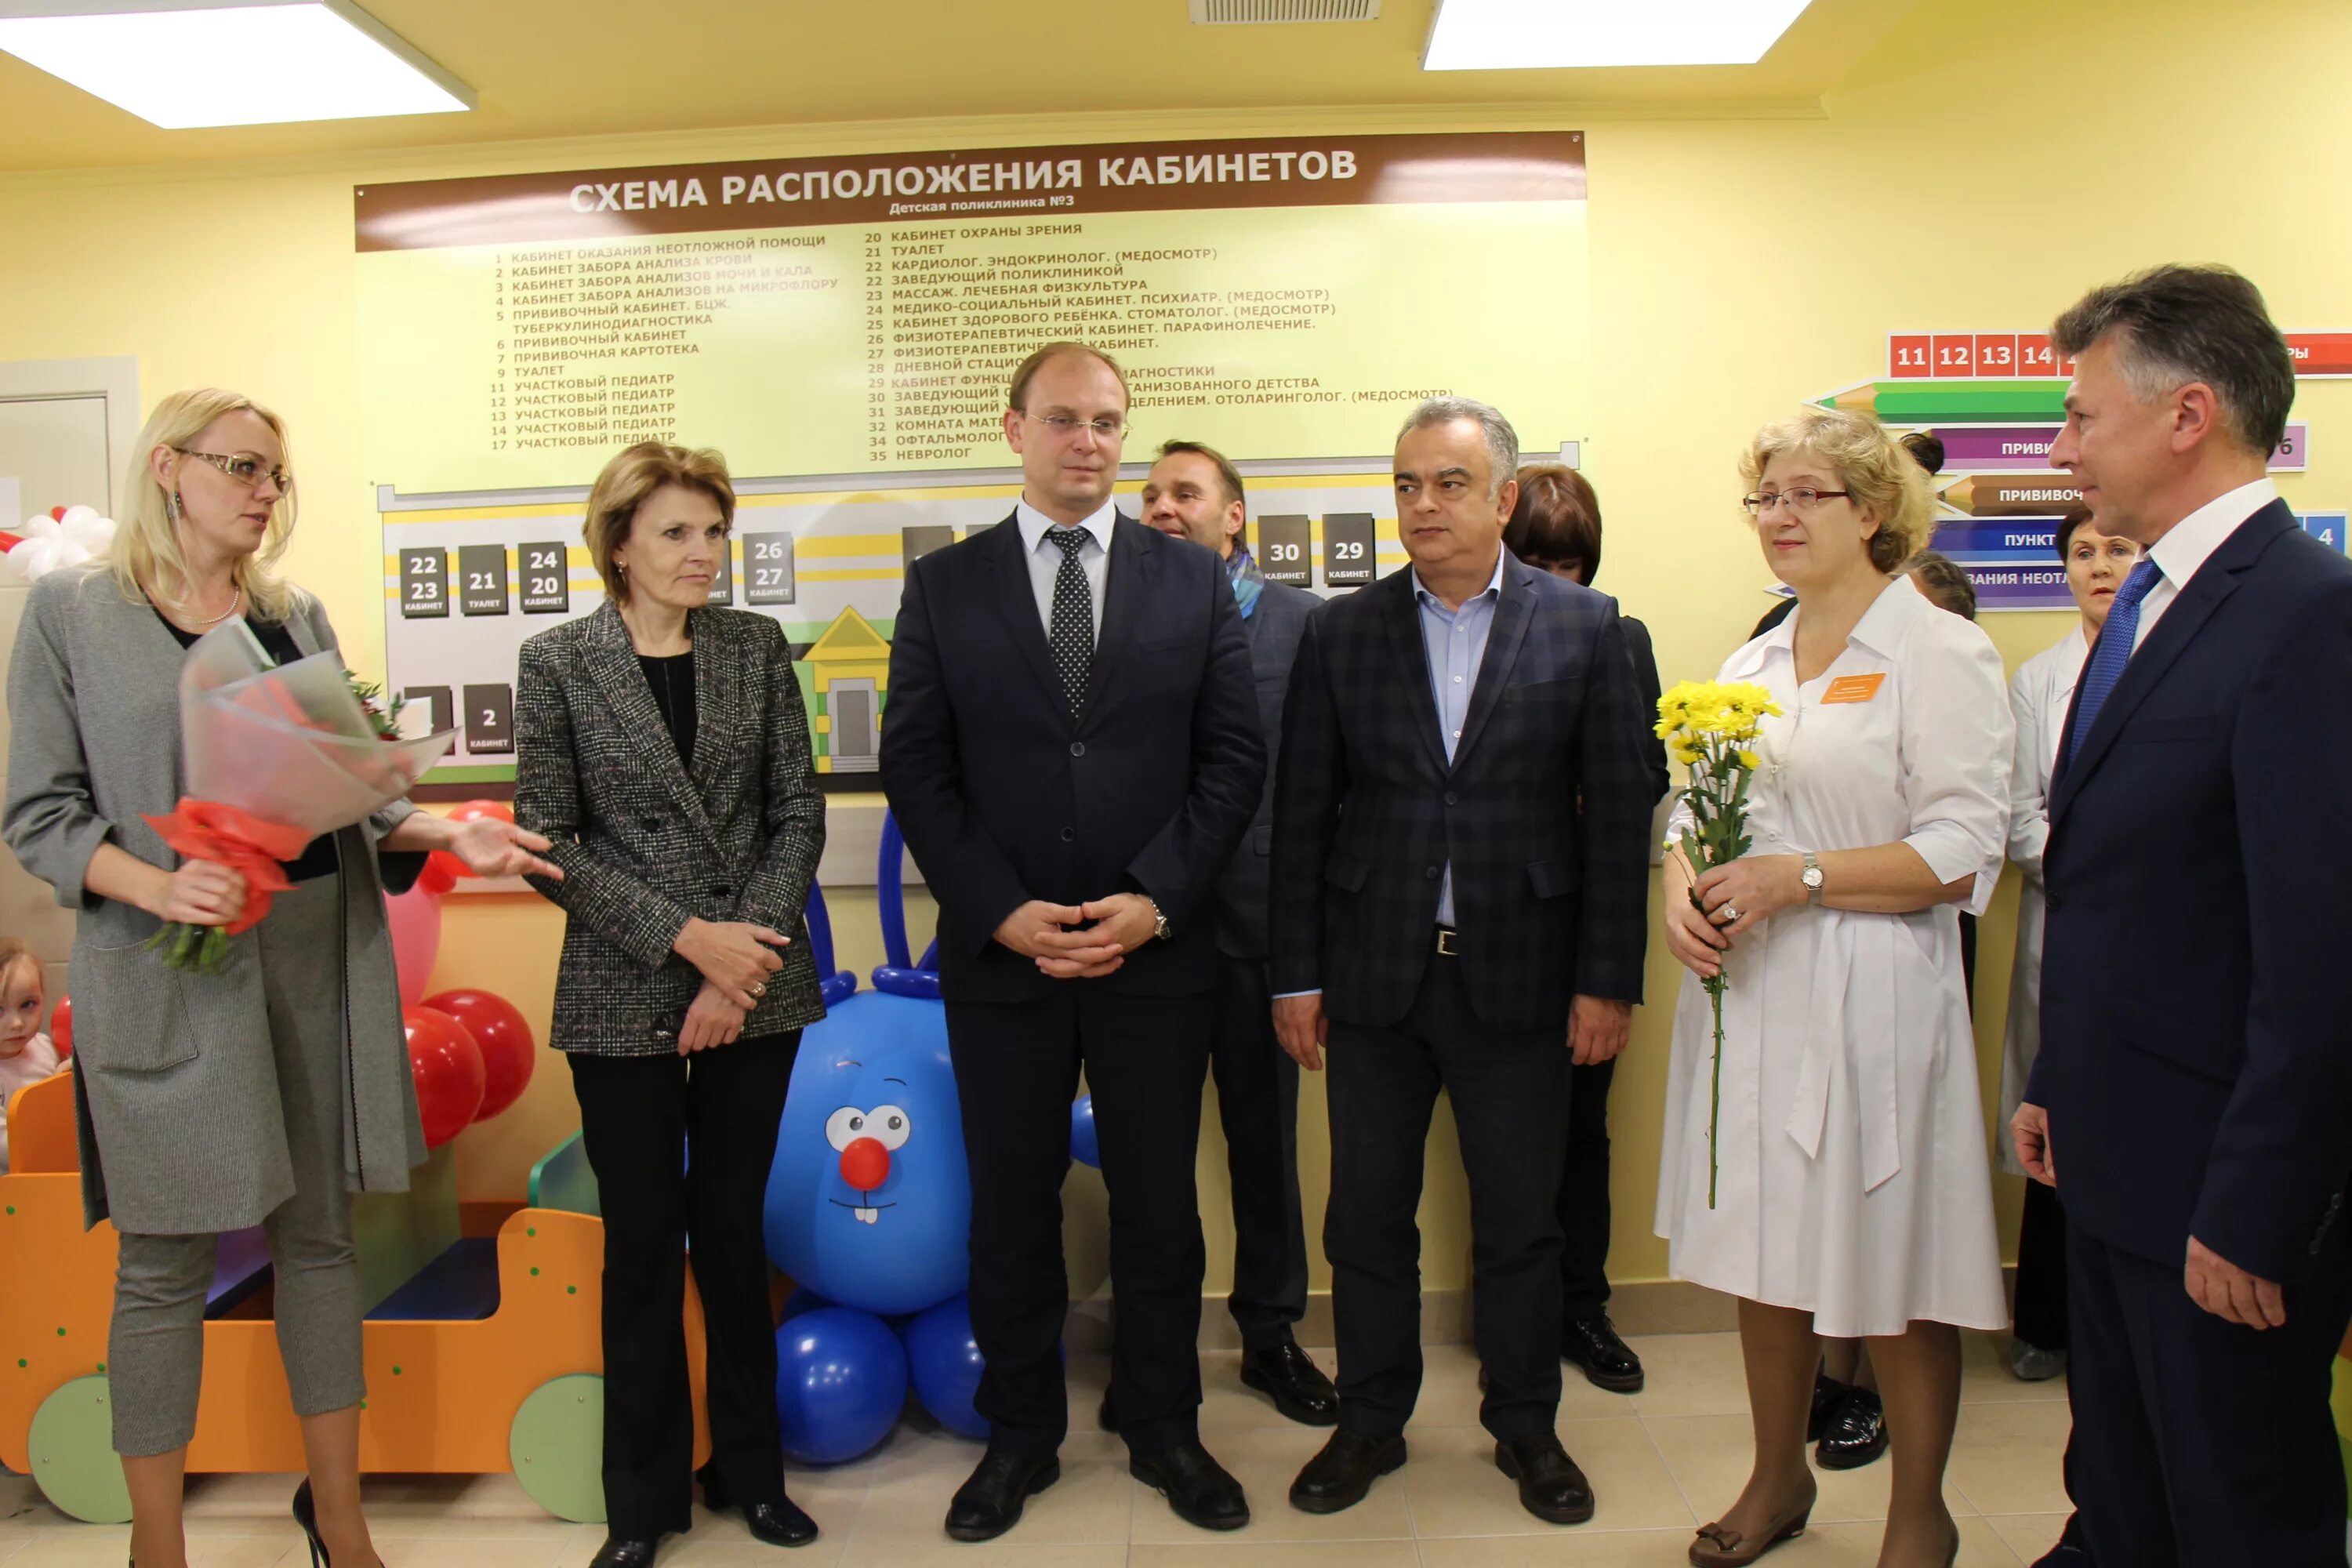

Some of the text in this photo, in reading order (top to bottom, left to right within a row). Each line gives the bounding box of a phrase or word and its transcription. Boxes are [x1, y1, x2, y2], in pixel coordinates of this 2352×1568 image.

[569, 151, 1356, 214] СХЕМА РАСПОЛОЖЕНИЯ КАБИНЕТОВ
[890, 195, 1075, 216] Детская поликлиника №3
[866, 223, 1081, 243] 20 КАБИНЕТ ОХРАНЫ ЗРЕНИЯ
[496, 236, 825, 264] 1 КАБИНЕТ ОКАЗАНИЯ НЕОТЛОЖНОЙ ПОМОЩИ
[866, 244, 944, 258] 21 ТУАЛЕТ
[496, 254, 751, 278] 2 КАБИНЕТ ЗАБОРА АНАЛИЗА КРОВИ
[866, 249, 1217, 272] 22 КАРДИОЛОГ. ЭНДОКРИНОЛОГ. (МЕДОСМОТР)
[497, 266, 812, 293] 3 КАБИНЕТ ЗАБОРА АНАЛИЗОВ МОЧИ И КАЛА
[867, 265, 1123, 286] 22 ЗАВЕДУЮЩИЙ ПОЛИКЛИНИКОЙ
[496, 278, 837, 307] 4 КАБИНЕТ ЗАБОРА АНАЛИЗОВ НА МИКРОФЛОРУ
[867, 280, 1147, 301] 23 МАССАЖ. ЛЕЧЕБНАЯ ФИЗКУЛЬТУРА
[497, 299, 730, 321] 5 ПРИВИВОЧНЫЙ КАБИНЕТ. БЦЖ.
[867, 289, 1329, 316] 24 МЕДИКО-СОЦИАЛЬНЫЙ КАБИНЕТ. ПСИХИАТР. (МЕДОСМОТР)
[514, 314, 712, 334] ТУБЕРКУЛИНОДИАГНОСТИКА
[867, 303, 1335, 330] 25 КАБИНЕТ ЗДОРОВОГО РЕБЁНКА. СТОМАТОЛОГ. (МЕДОСМОТР)
[497, 329, 685, 350] 6 ПРИВИВОЧНЫЙ КАБИНЕТ
[868, 319, 1315, 345] 26 ФИЗИОТЕРАПЕВТИЧЕСКИЙ КАБИНЕТ. ПАРАФИНОЛЕЧЕНИЕ.
[499, 343, 699, 364] 7 ПРИВИВОЧНАЯ КАРТОТЕКА
[868, 337, 1159, 359] 27 ФИЗИОТЕРАПЕВТИЧЕ КАБИНЕТ.
[1899, 347, 1925, 365] 11
[1940, 347, 1968, 365] 12
[1984, 346, 2010, 365] 13
[2025, 347, 2053, 365] 14
[498, 365, 564, 379] 9 ТУАЛЕТ
[869, 358, 1024, 374] 28 ДНЕВНОЙ СТАЦИО
[492, 374, 674, 394] 11 УЧАСТКОВЫЙ ПЕДИАТР
[869, 366, 1214, 389] 29 КАБИНЕТ ФУНКЦ АГНОСТИКИ
[492, 388, 674, 408] 12 УЧАСТКОВЫЙ ПЕДИАТР
[869, 392, 884, 403] 30
[895, 386, 998, 402] ЗАВЕДУЮЩИЙ
[1256, 377, 1319, 391] ДЕТСТВА
[492, 402, 674, 421] 13 УЧАСТКОВЫЙ ПЕДИАТР
[869, 407, 884, 418] 31
[895, 401, 999, 417] ЗАВЕДУЮЩИЙ
[1129, 395, 1209, 408] ДЕЛЕНИЕМ.
[1216, 391, 1345, 405] ОТОЛАРИНГОЛОГ.
[1352, 389, 1453, 404] (МЕДОСМОТР)
[493, 417, 675, 436] 14 УЧАСТКОВЫЙ ПЕДИАТР
[869, 416, 1004, 432] 32 КОМНАТА МАТЕ
[493, 431, 675, 450] 17 УЧАСТКОВЫЙ ПЕДИАТР
[870, 430, 1005, 447] 34 ОФТАЛЬМОЛОГ
[870, 448, 971, 462] 35 НЕВРОЛОГ
[2002, 443, 2051, 455] ПРИВИ
[2000, 489, 2083, 502] ПРИВИВОЧ
[2005, 534, 2055, 546] ПУНКТ
[2318, 527, 2334, 546] 4
[756, 541, 782, 559] 26
[1271, 543, 1299, 561] 30
[1336, 542, 1363, 560] 29
[411, 557, 437, 574] 22
[531, 551, 557, 569] 24
[470, 572, 495, 590] 21
[532, 576, 557, 594] 20
[757, 568, 782, 586] 27
[1265, 572, 1305, 580] КАБИНЕТ
[1966, 573, 2017, 586] ЗАНИЯ
[412, 582, 437, 600] 23
[750, 588, 789, 597] КАБИНЕТ
[405, 601, 442, 611] КАБИНЕТ
[524, 597, 562, 605] КАБИНЕТ
[484, 710, 495, 726] 2
[470, 739, 507, 748] КАБИНЕТ
